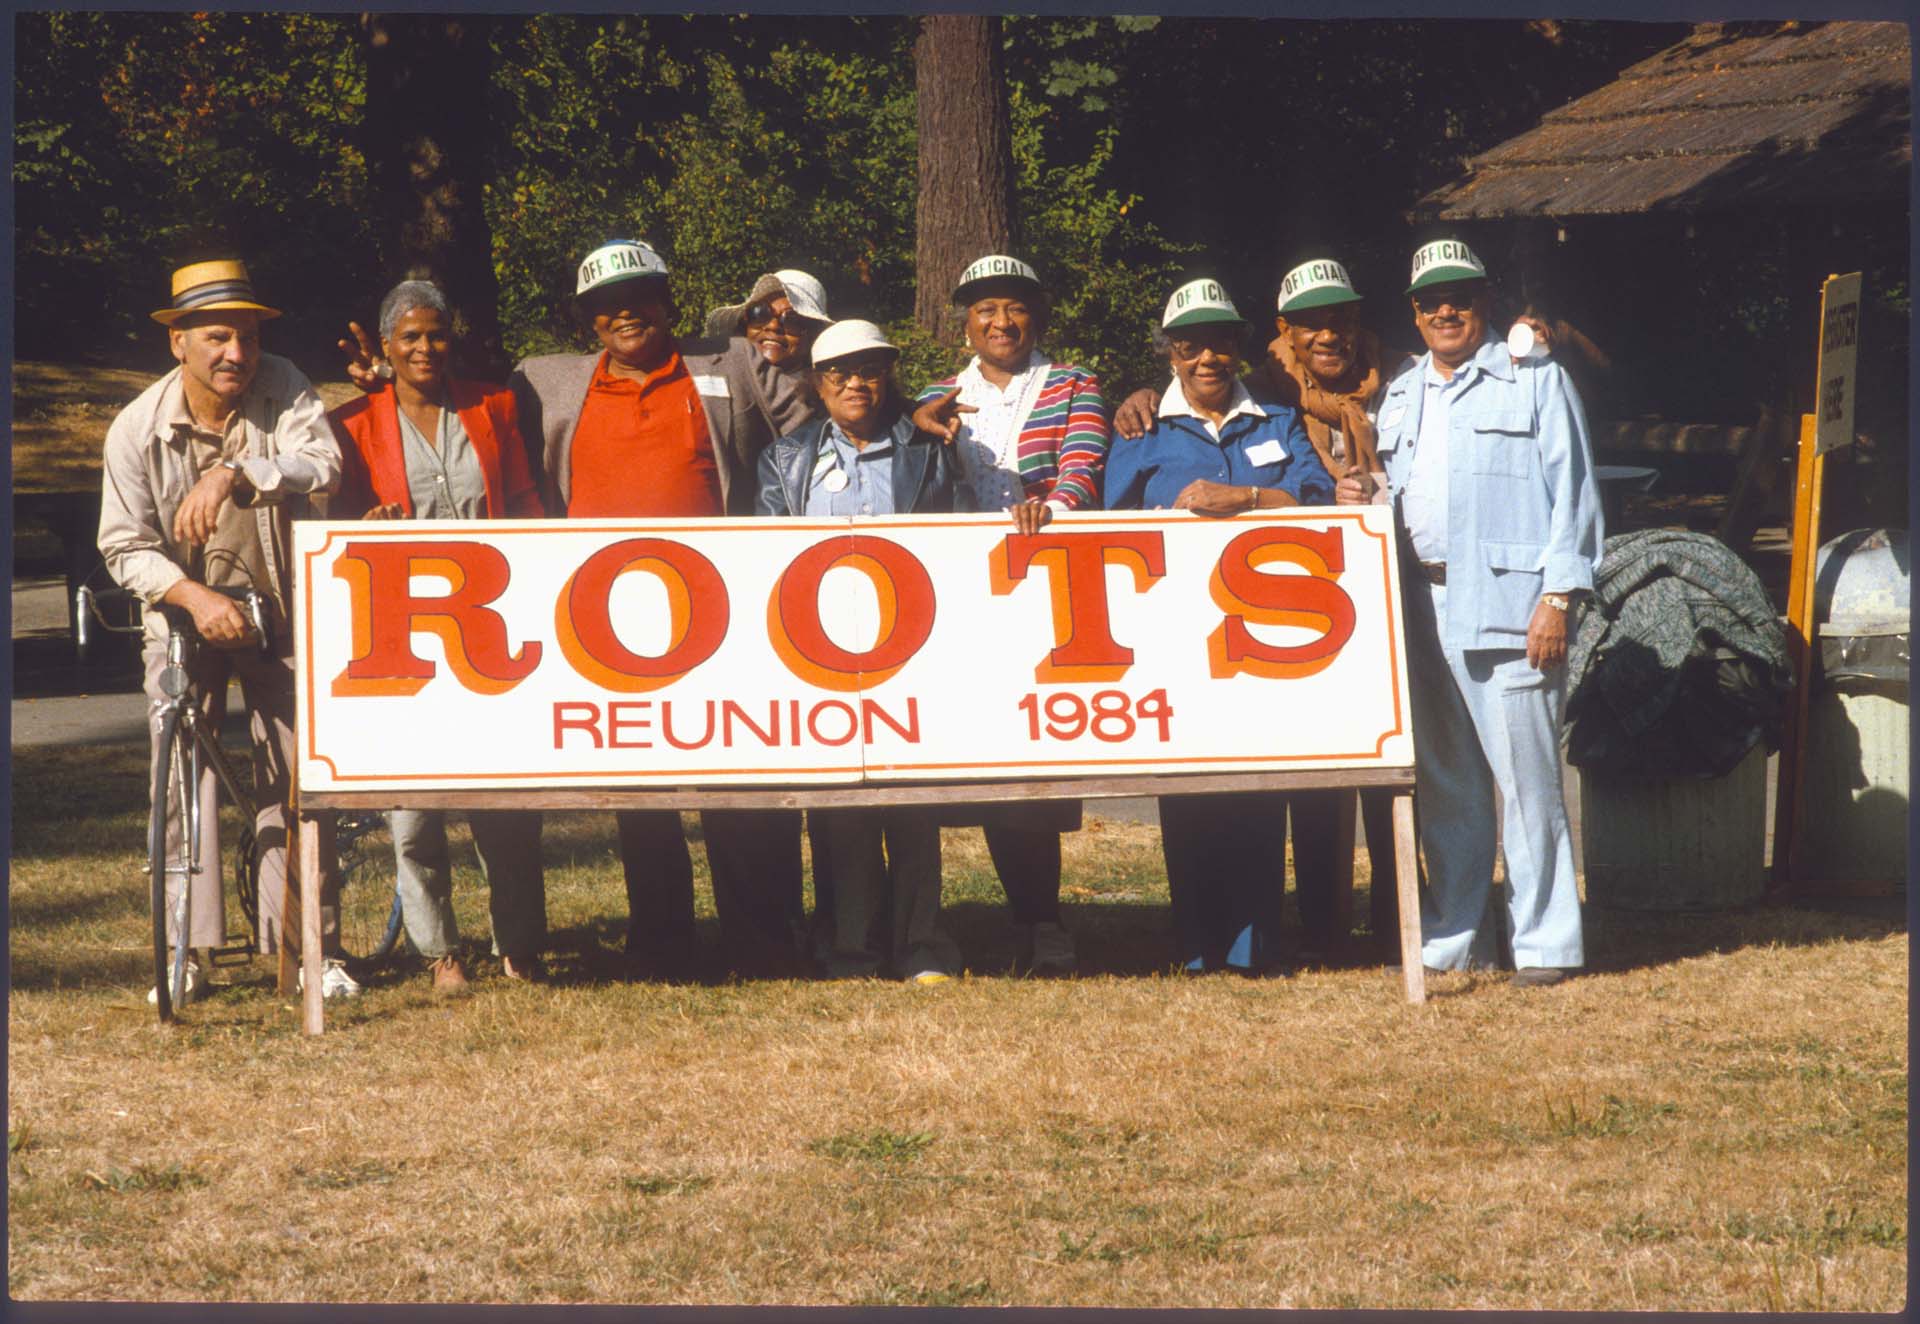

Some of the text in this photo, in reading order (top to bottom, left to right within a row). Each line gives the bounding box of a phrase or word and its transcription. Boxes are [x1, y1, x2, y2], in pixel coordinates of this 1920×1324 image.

[582, 250, 648, 284] OFFCIAL
[1414, 243, 1475, 272] OFFICIAL
[331, 526, 1357, 697] ROOTS
[552, 688, 1174, 750] REUNION 1984
